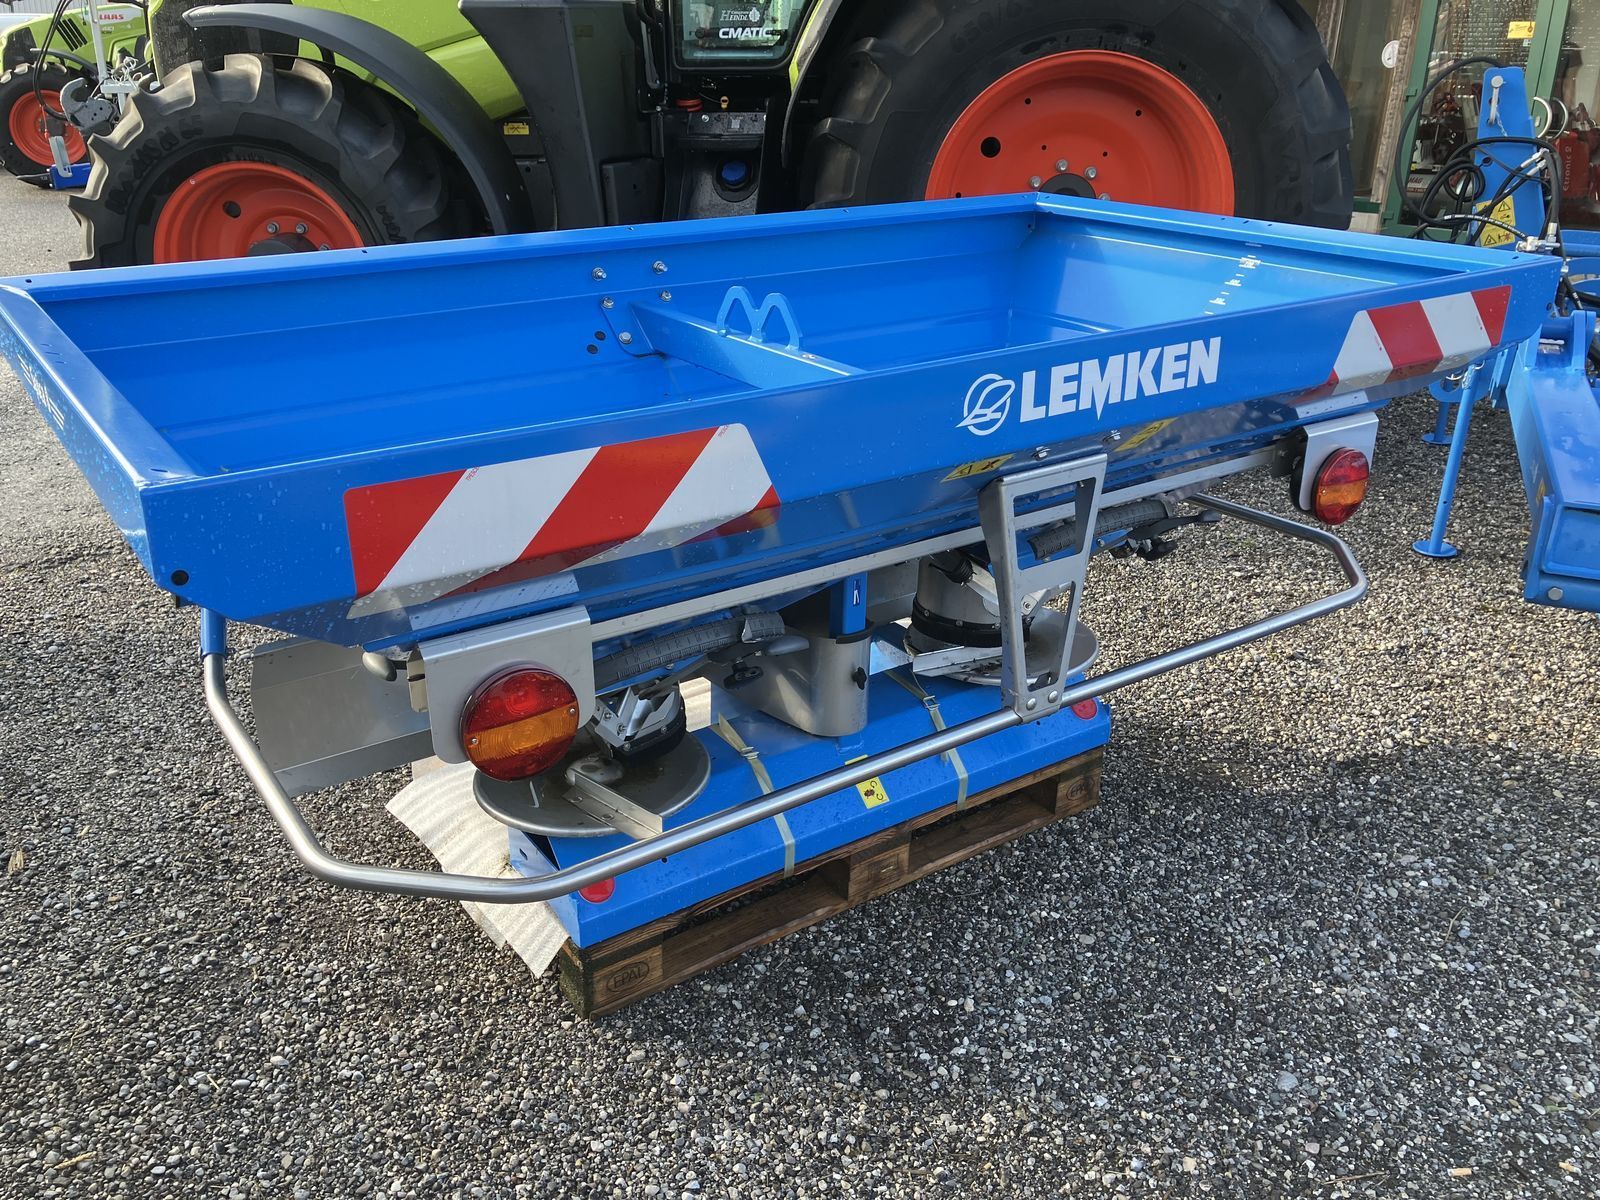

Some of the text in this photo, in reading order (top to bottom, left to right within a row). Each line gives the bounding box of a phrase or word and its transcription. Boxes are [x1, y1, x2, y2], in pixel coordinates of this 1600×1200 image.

[718, 27, 773, 39] CMATIC
[1020, 336, 1222, 421] LEMKEN
[613, 966, 645, 988] EPAL
